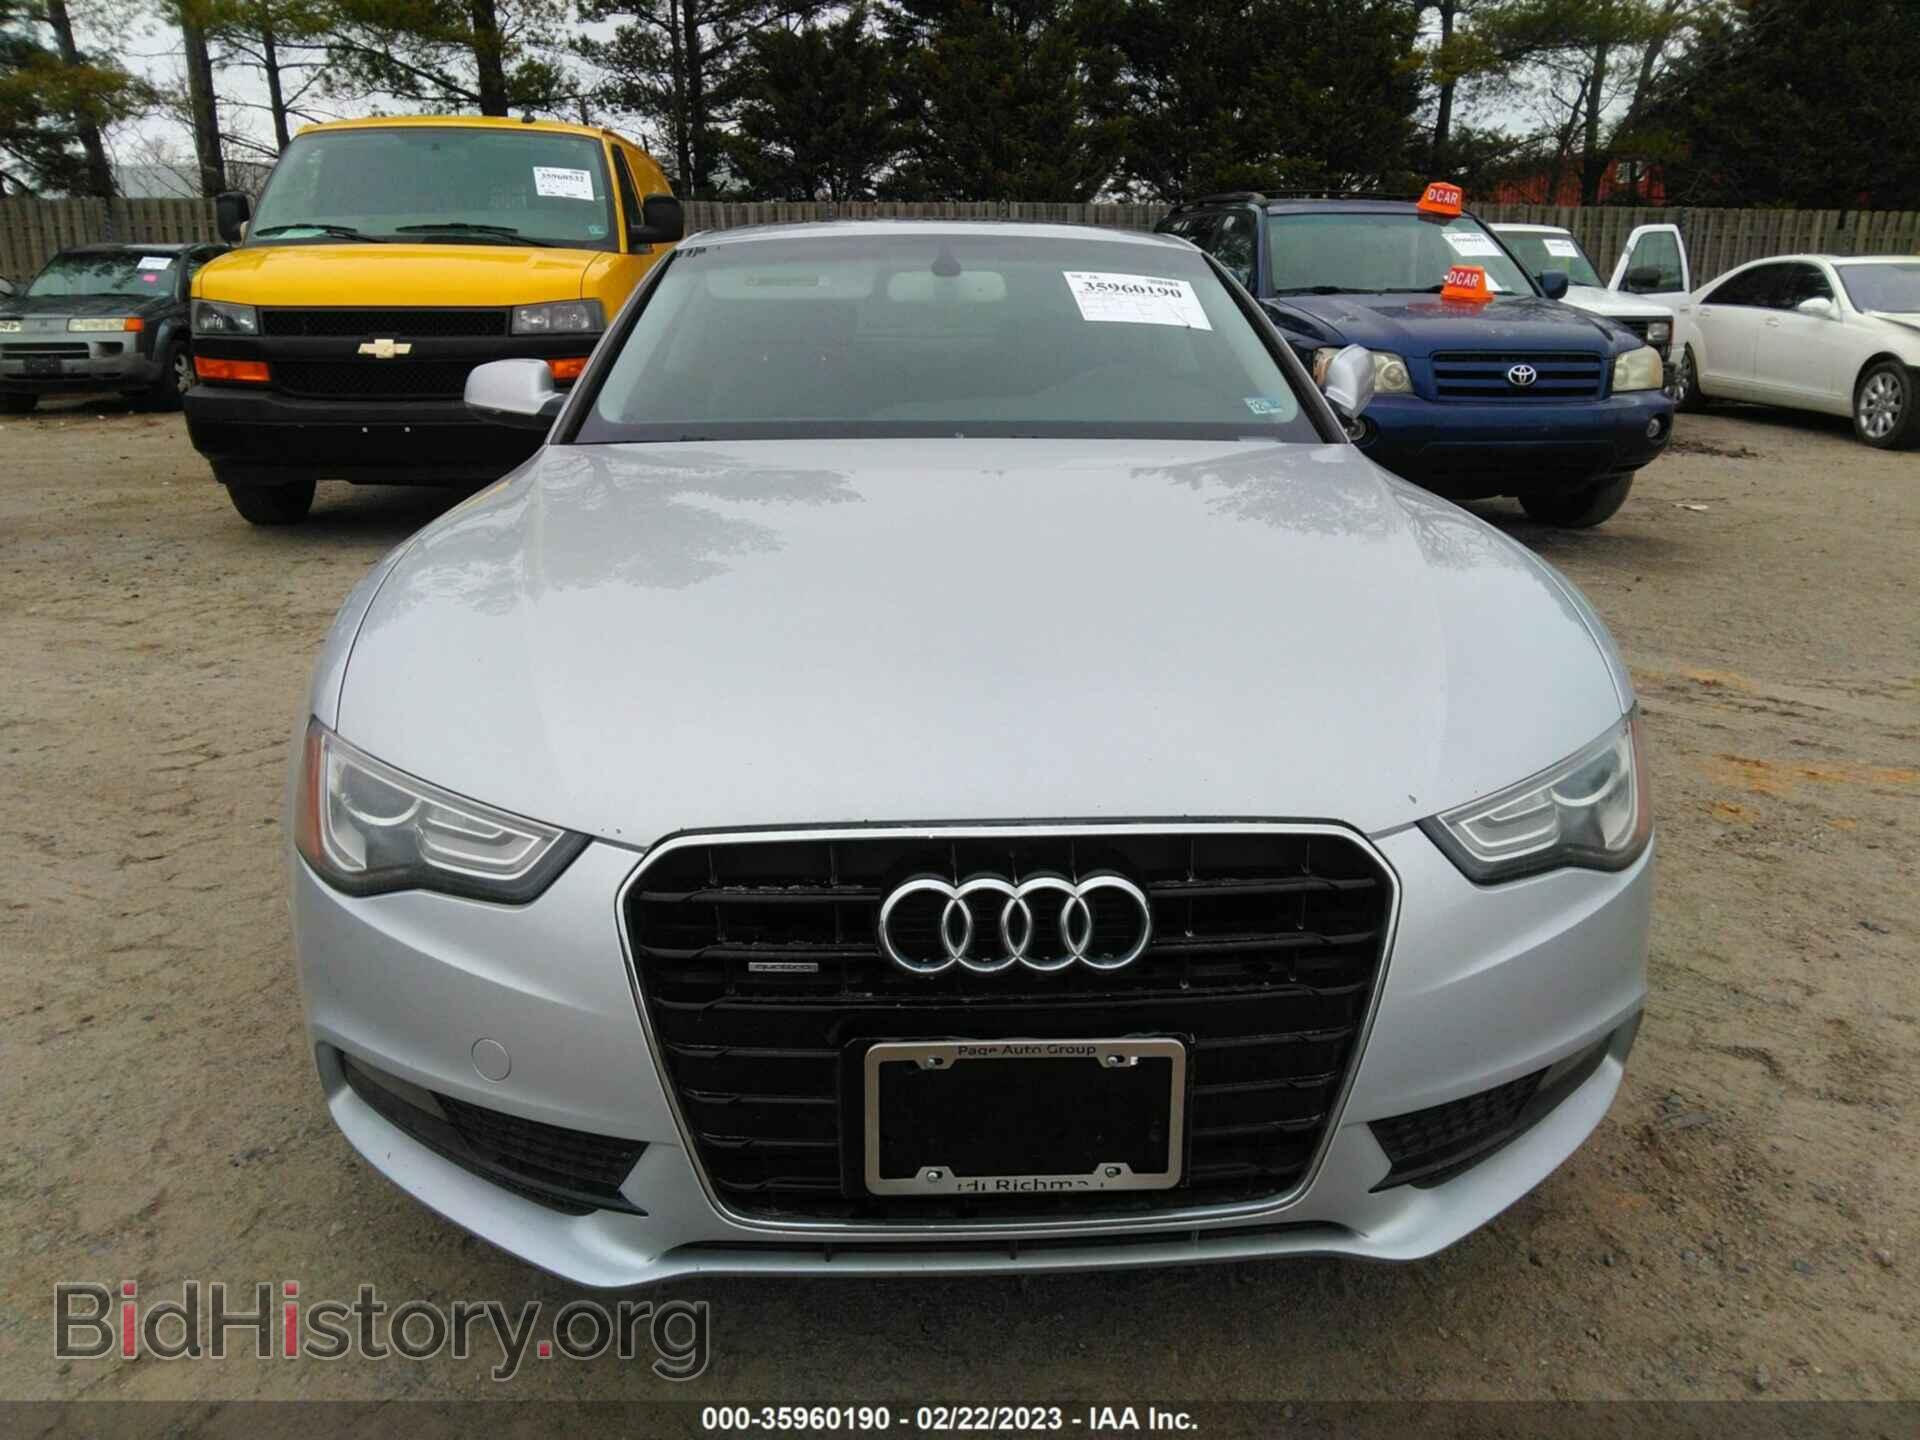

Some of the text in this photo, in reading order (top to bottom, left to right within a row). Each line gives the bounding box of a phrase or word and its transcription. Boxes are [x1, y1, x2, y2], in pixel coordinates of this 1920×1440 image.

[1428, 189, 1458, 204] DCAR
[1448, 271, 1480, 287] DCAR
[1083, 281, 1183, 299] 35960190
[1046, 1044, 1097, 1056] Group
